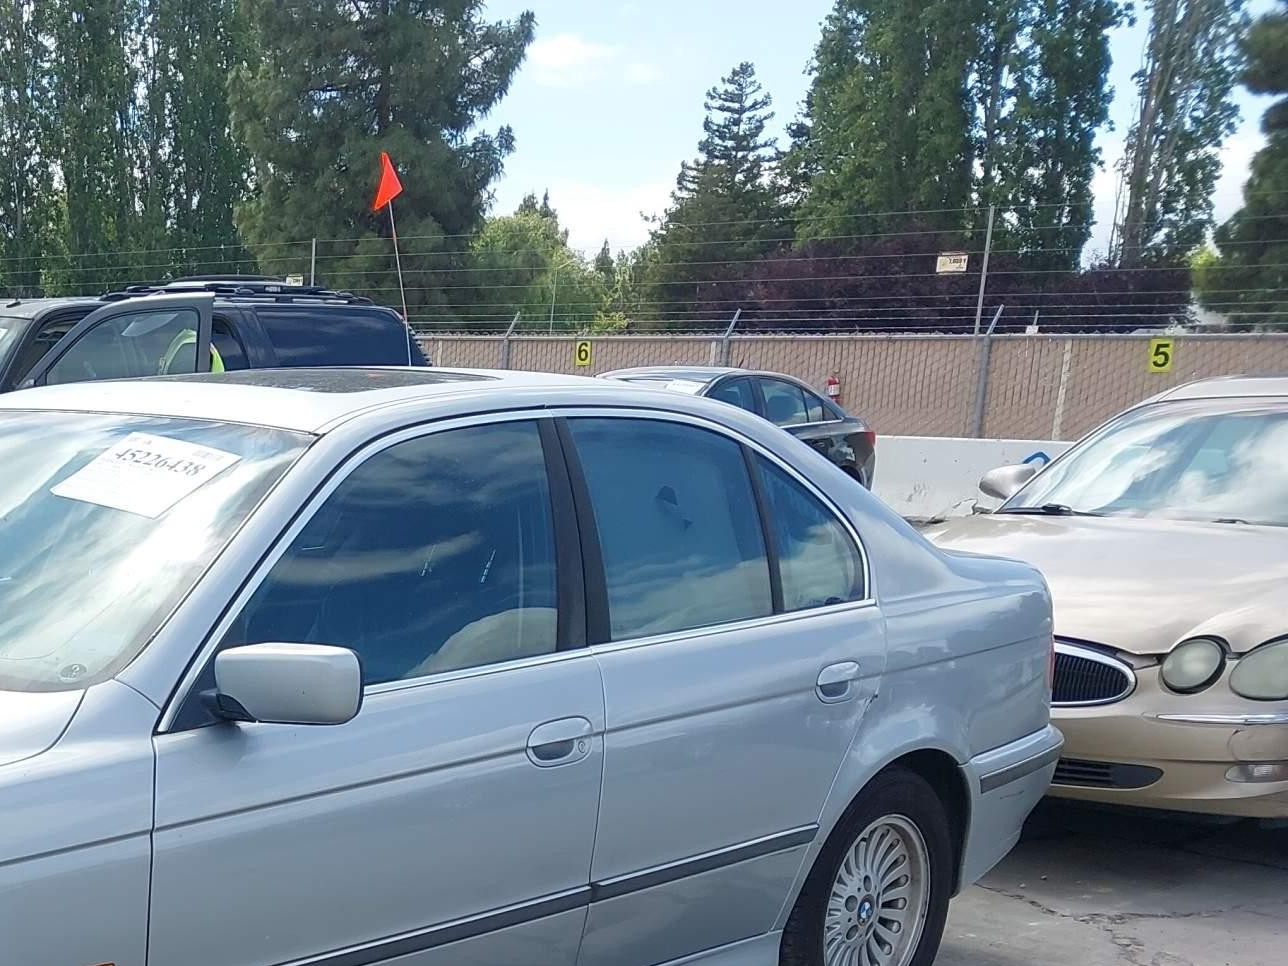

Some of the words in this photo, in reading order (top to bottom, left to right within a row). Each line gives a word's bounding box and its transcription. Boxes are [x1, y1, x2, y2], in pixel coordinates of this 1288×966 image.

[577, 342, 589, 362] 6
[1152, 343, 1170, 368] 5
[115, 448, 206, 477] 45226438
